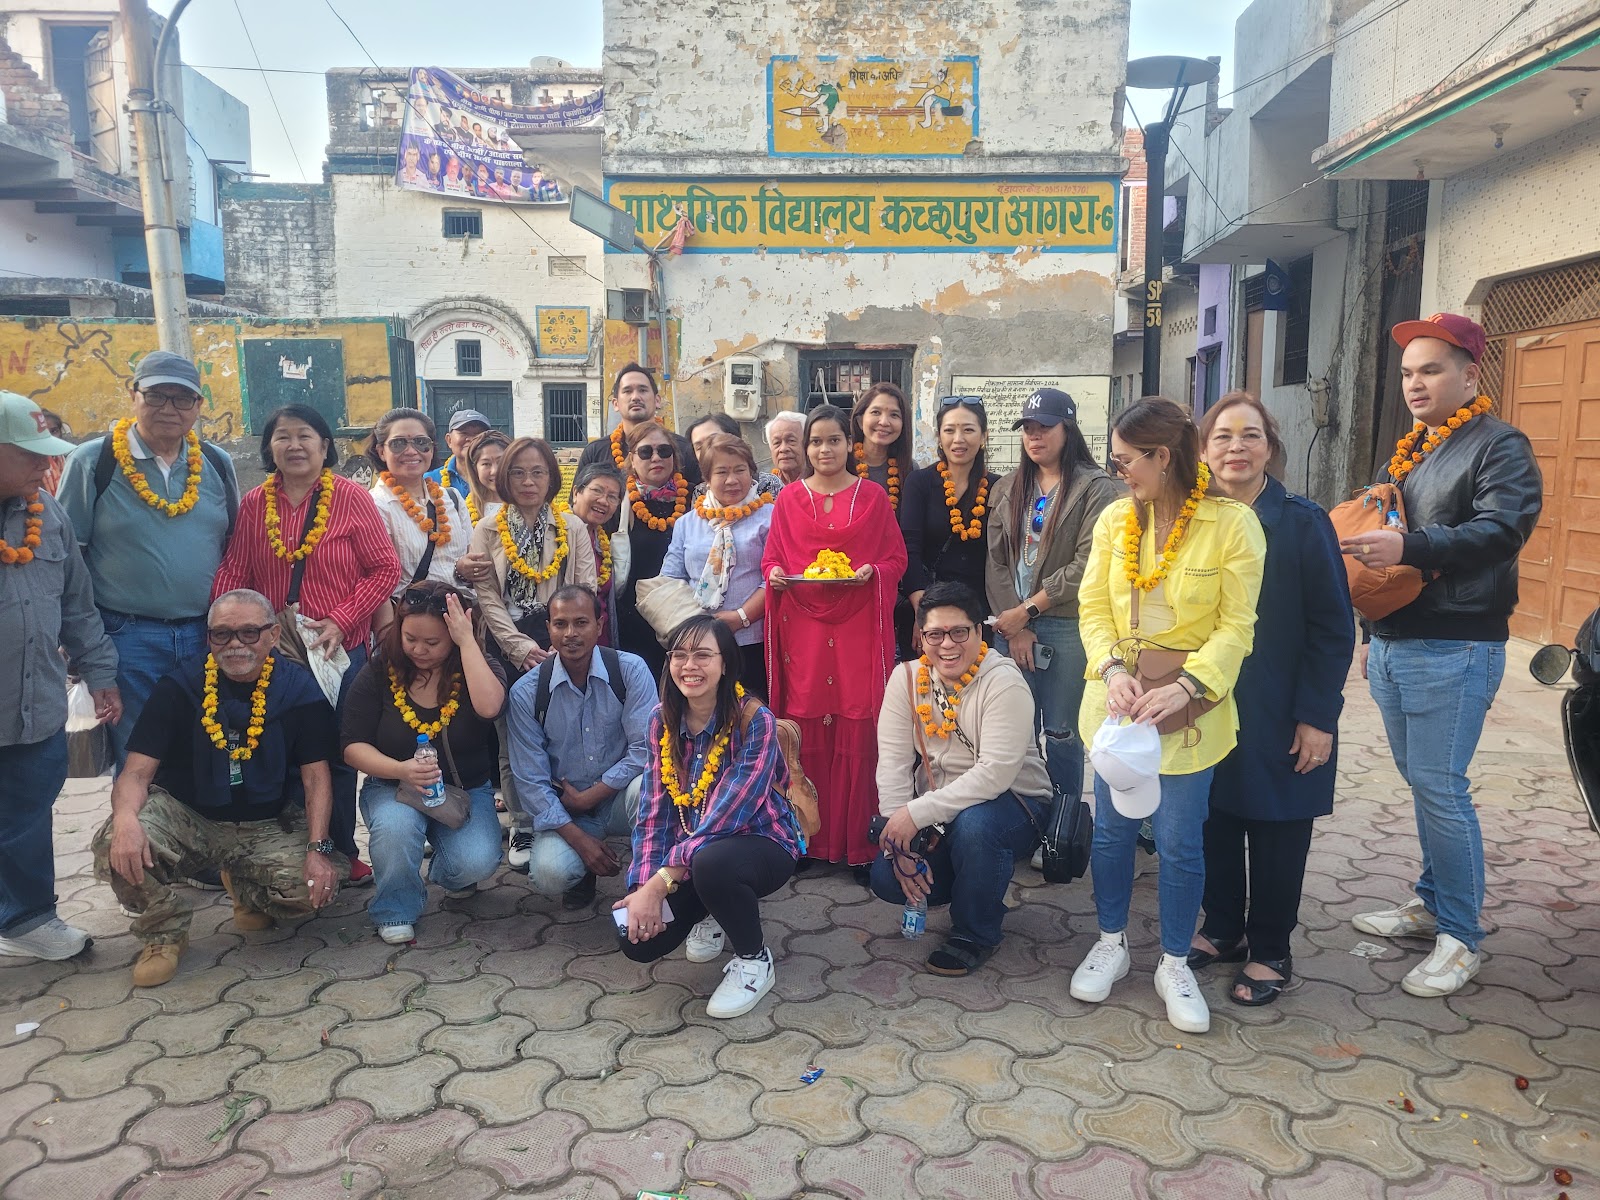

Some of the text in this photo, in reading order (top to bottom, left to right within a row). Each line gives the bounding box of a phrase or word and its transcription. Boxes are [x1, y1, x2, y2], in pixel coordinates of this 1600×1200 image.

[751, 185, 875, 235] विद्यालय
[1147, 280, 1163, 300] SP
[1146, 308, 1162, 327] 58
